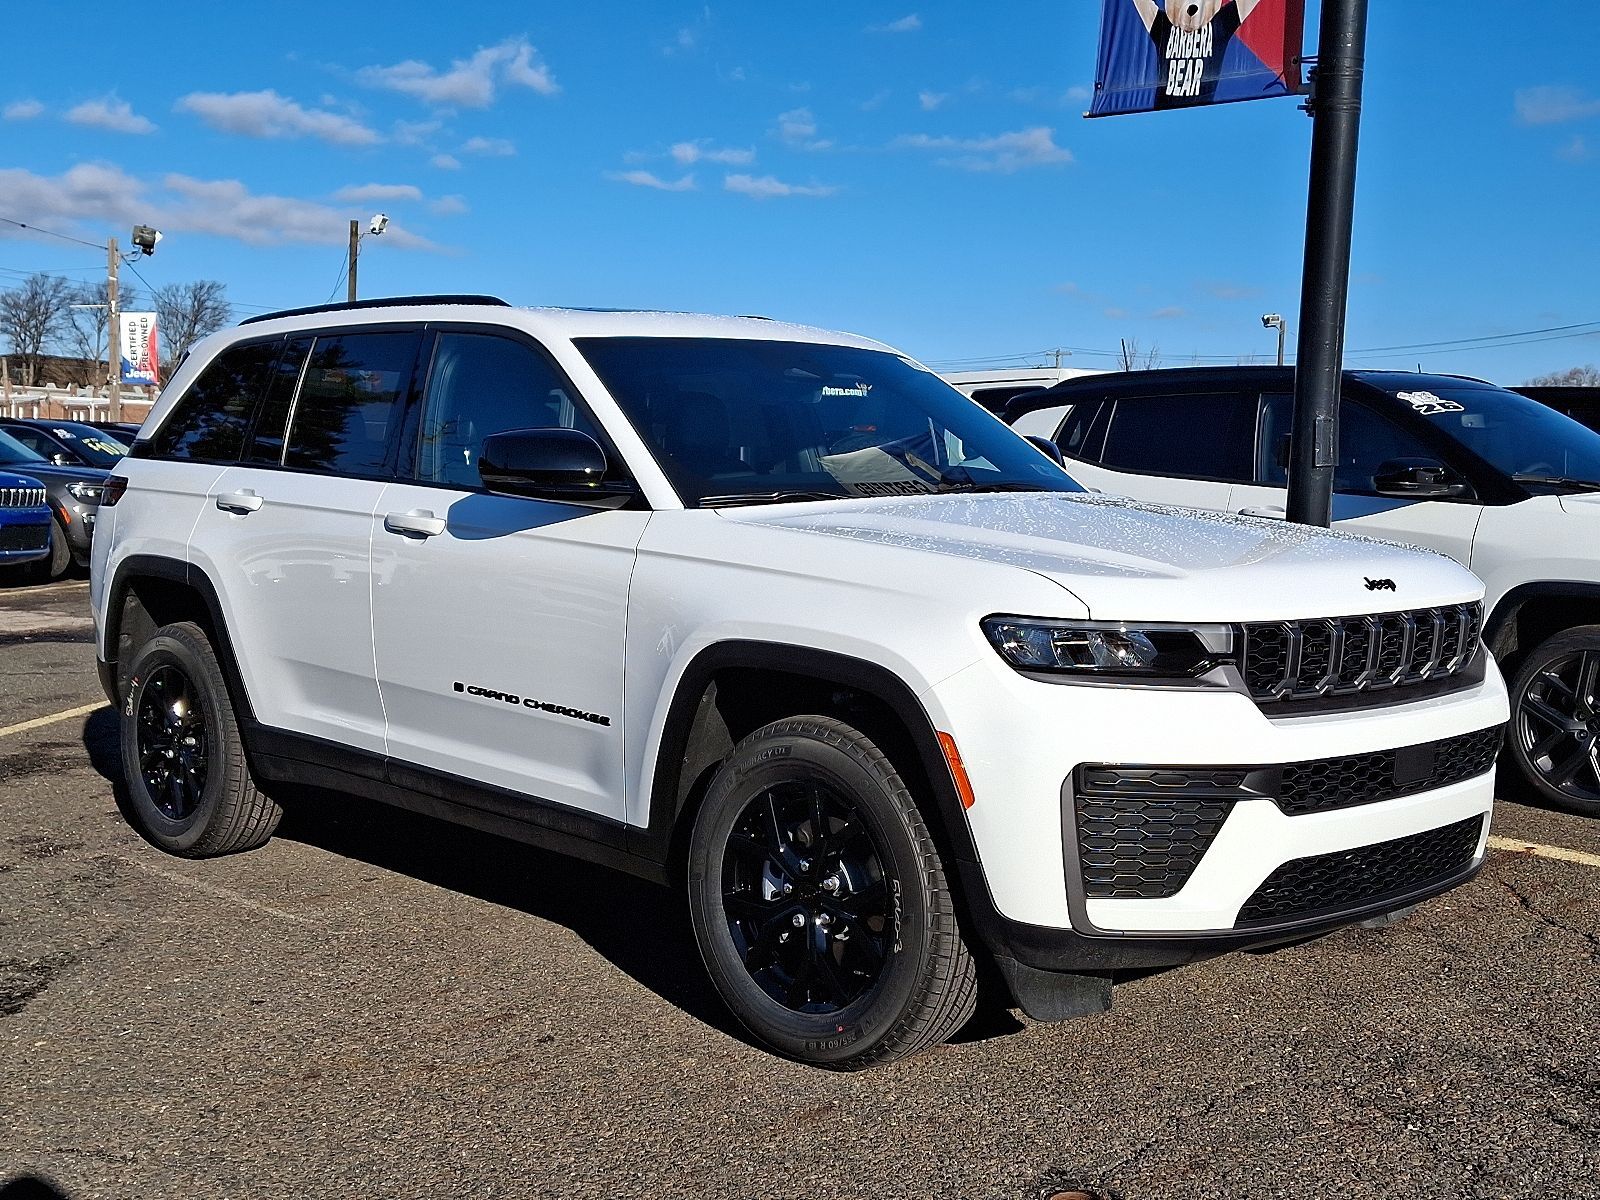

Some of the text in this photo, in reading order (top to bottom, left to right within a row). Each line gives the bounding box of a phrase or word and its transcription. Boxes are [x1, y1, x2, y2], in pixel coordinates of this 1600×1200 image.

[1166, 22, 1212, 58] BARBERA
[1166, 59, 1203, 96] BEAR
[129, 321, 138, 367] CERTIFIED
[141, 318, 149, 369] PRE-OWNED
[126, 369, 154, 380] Jeep
[1363, 577, 1396, 592] Jeep
[467, 685, 611, 726] GRAND CHEROKEE
